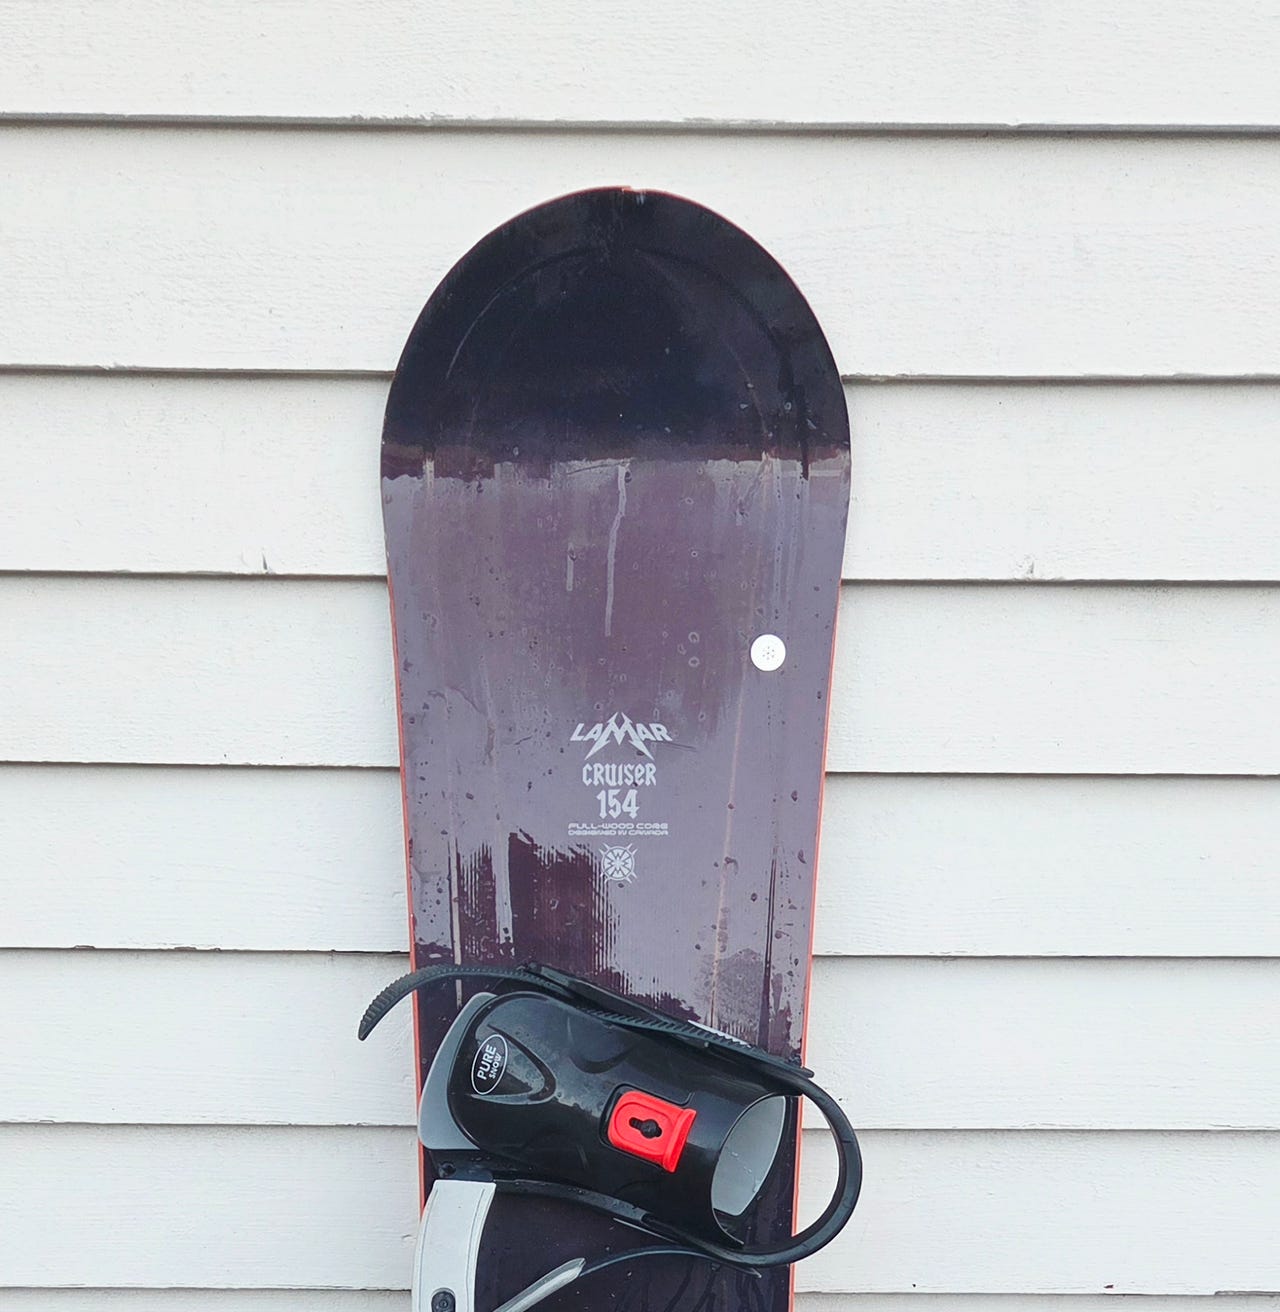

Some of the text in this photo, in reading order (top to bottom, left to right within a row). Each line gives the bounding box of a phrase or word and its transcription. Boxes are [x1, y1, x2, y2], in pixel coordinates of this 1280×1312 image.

[570, 712, 673, 761] LAMAR
[596, 789, 640, 819] 154
[635, 822, 669, 830] CORE
[477, 1044, 496, 1080] PURE
[489, 1052, 502, 1079] SNOW
